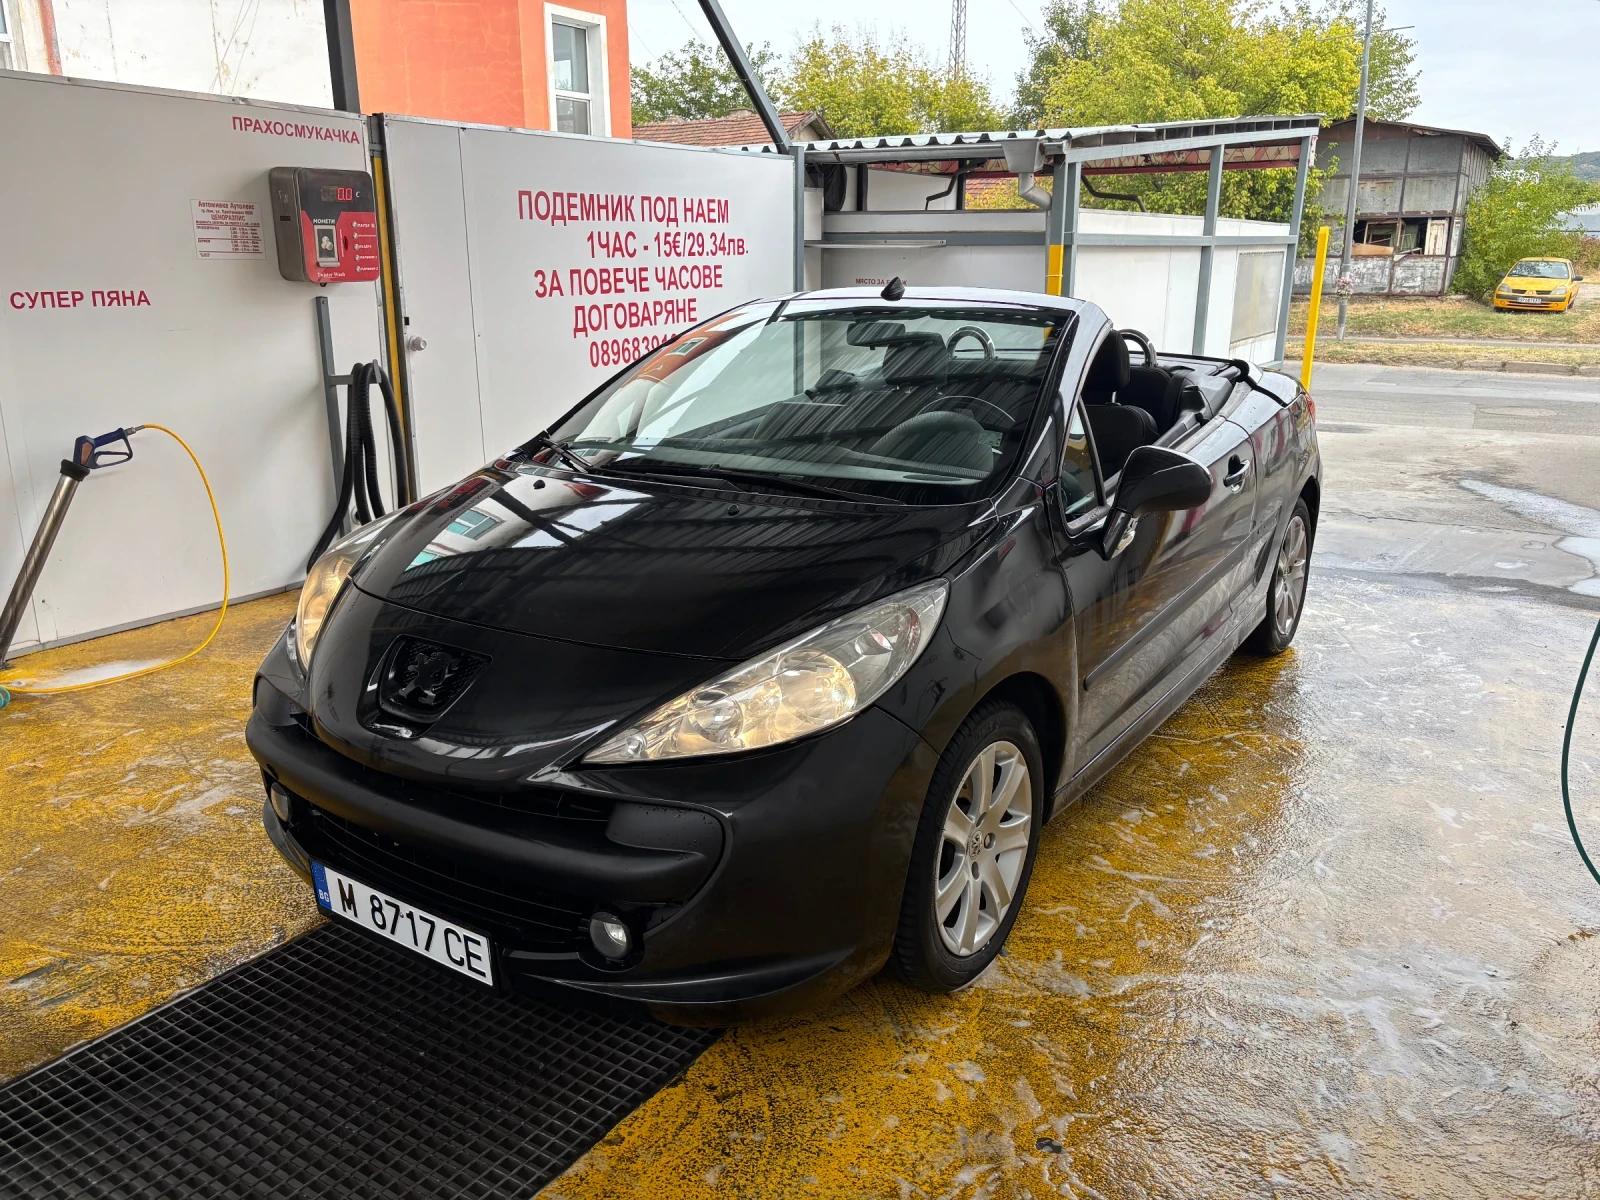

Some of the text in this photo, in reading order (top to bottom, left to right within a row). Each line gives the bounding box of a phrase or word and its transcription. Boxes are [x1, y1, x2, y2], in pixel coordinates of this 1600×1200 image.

[232, 116, 360, 144] ПРАХОСМУКАЧКА
[518, 190, 729, 228] ПОДЕМНИК ПОД НАЕМ
[586, 230, 637, 259] 1ЧАС
[654, 231, 749, 258] 15€/29.34лв.
[534, 264, 723, 298] ЗА ПОВЕЧЕ ЧАСОВЕ
[10, 290, 151, 309] СУПЕР ПЯНА
[573, 298, 698, 338] ДОГОВАРЯНЕ
[318, 889, 330, 903] BG
[337, 877, 487, 978] M 8717 CE
